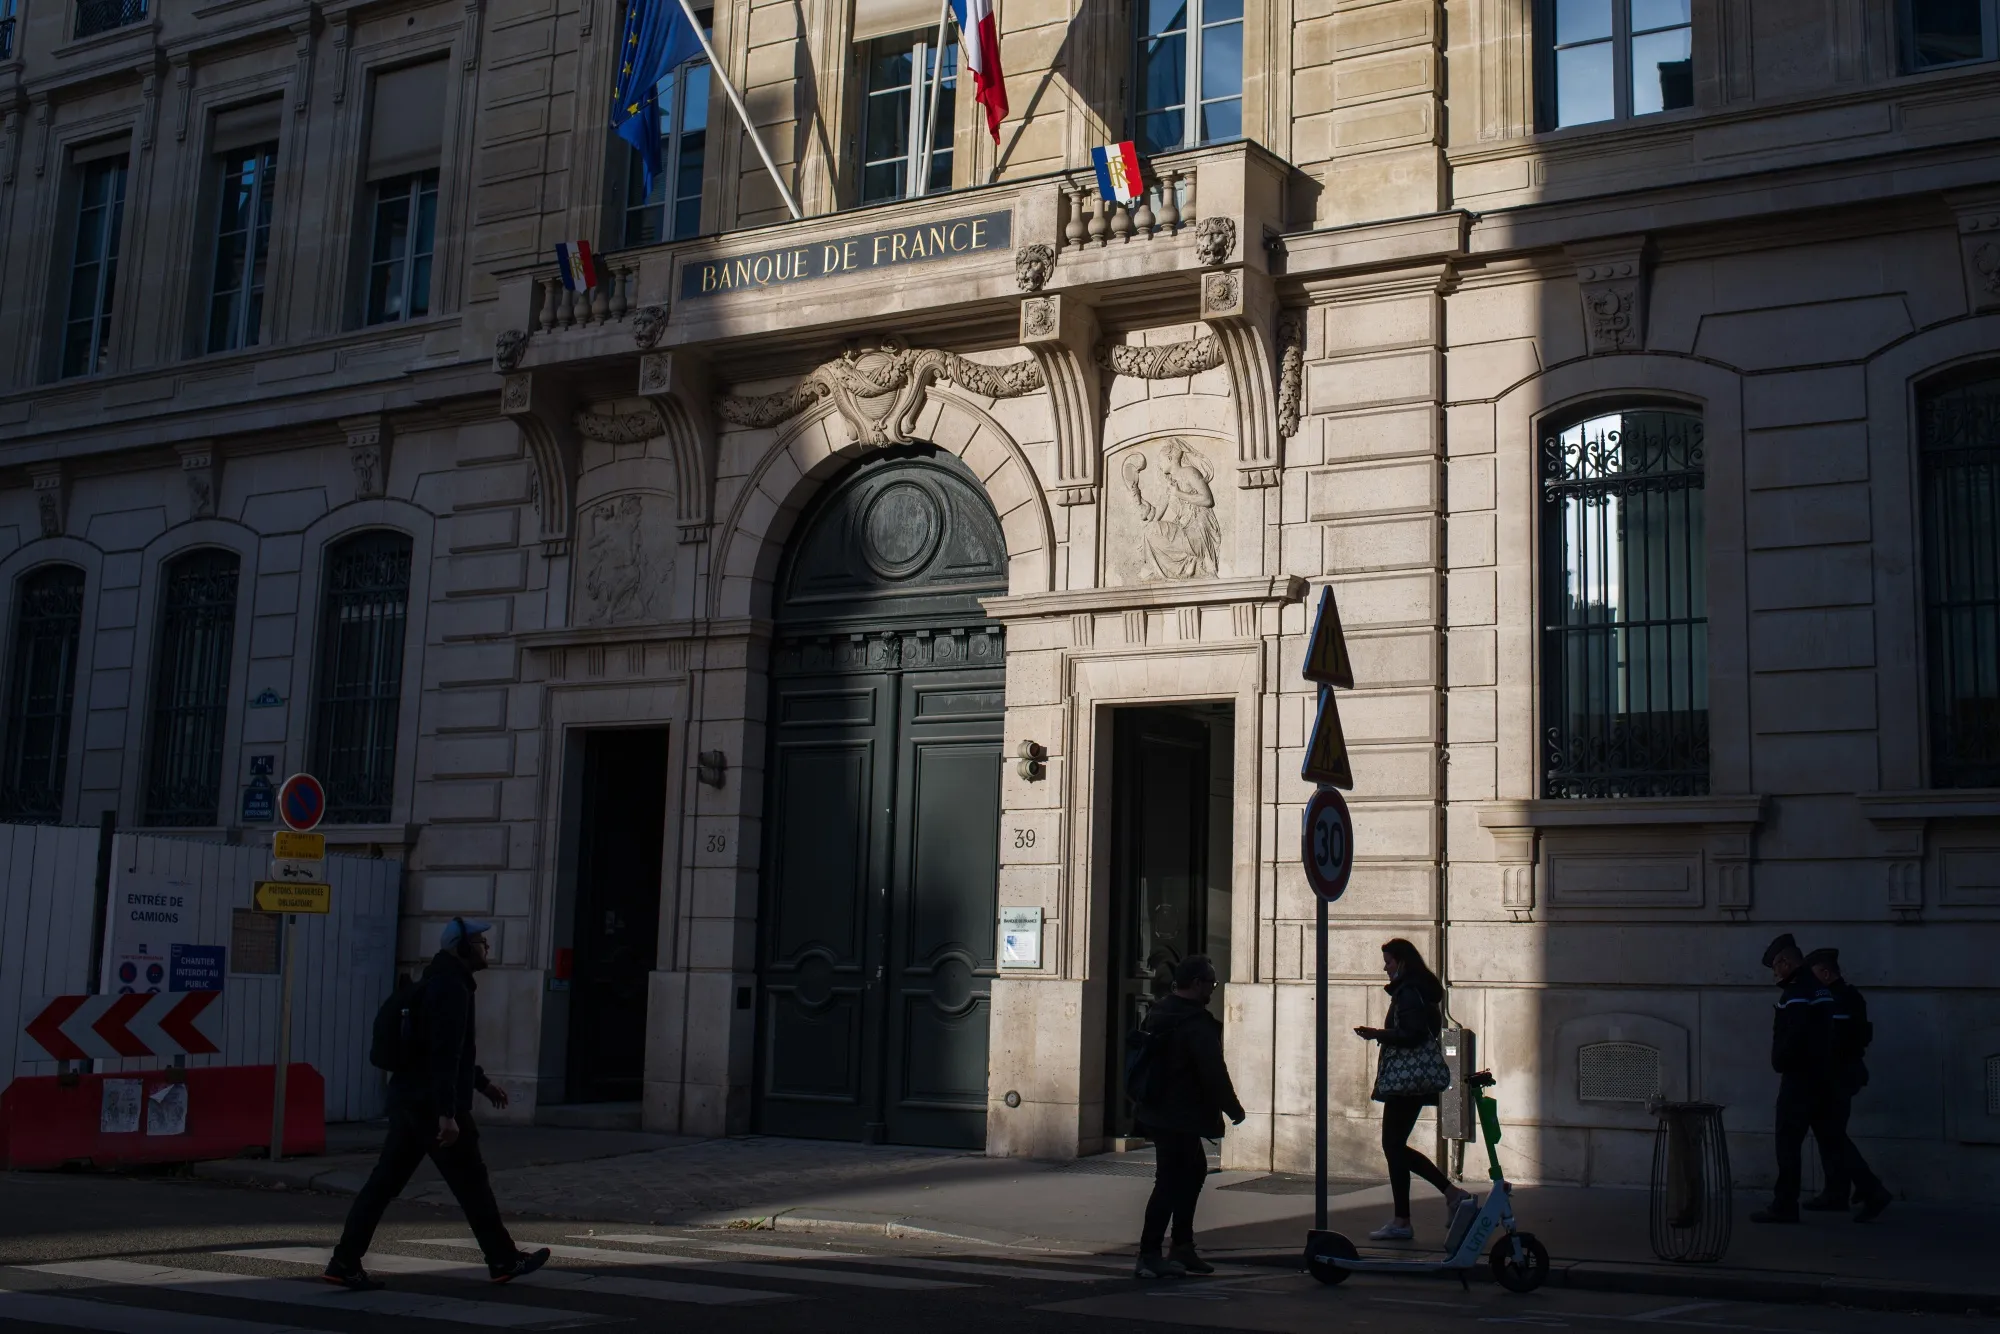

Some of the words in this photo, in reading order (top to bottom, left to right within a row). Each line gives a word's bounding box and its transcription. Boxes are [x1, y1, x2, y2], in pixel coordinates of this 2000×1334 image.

[702, 248, 810, 293] BANQUE
[823, 240, 859, 275] DE
[872, 219, 990, 266] FRANCE
[706, 835, 726, 853] 39
[1014, 829, 1036, 849] 39
[1316, 820, 1344, 867] 30
[127, 893, 167, 906] ENTRÉE
[170, 896, 184, 907] DE
[278, 898, 313, 907] OBLIGATOIRE
[131, 911, 179, 923] CAMIONS
[180, 957, 215, 966] CHANTIER
[176, 968, 207, 977] INTERDIT
[209, 969, 219, 977] AU
[185, 980, 210, 988] PUBLIC
